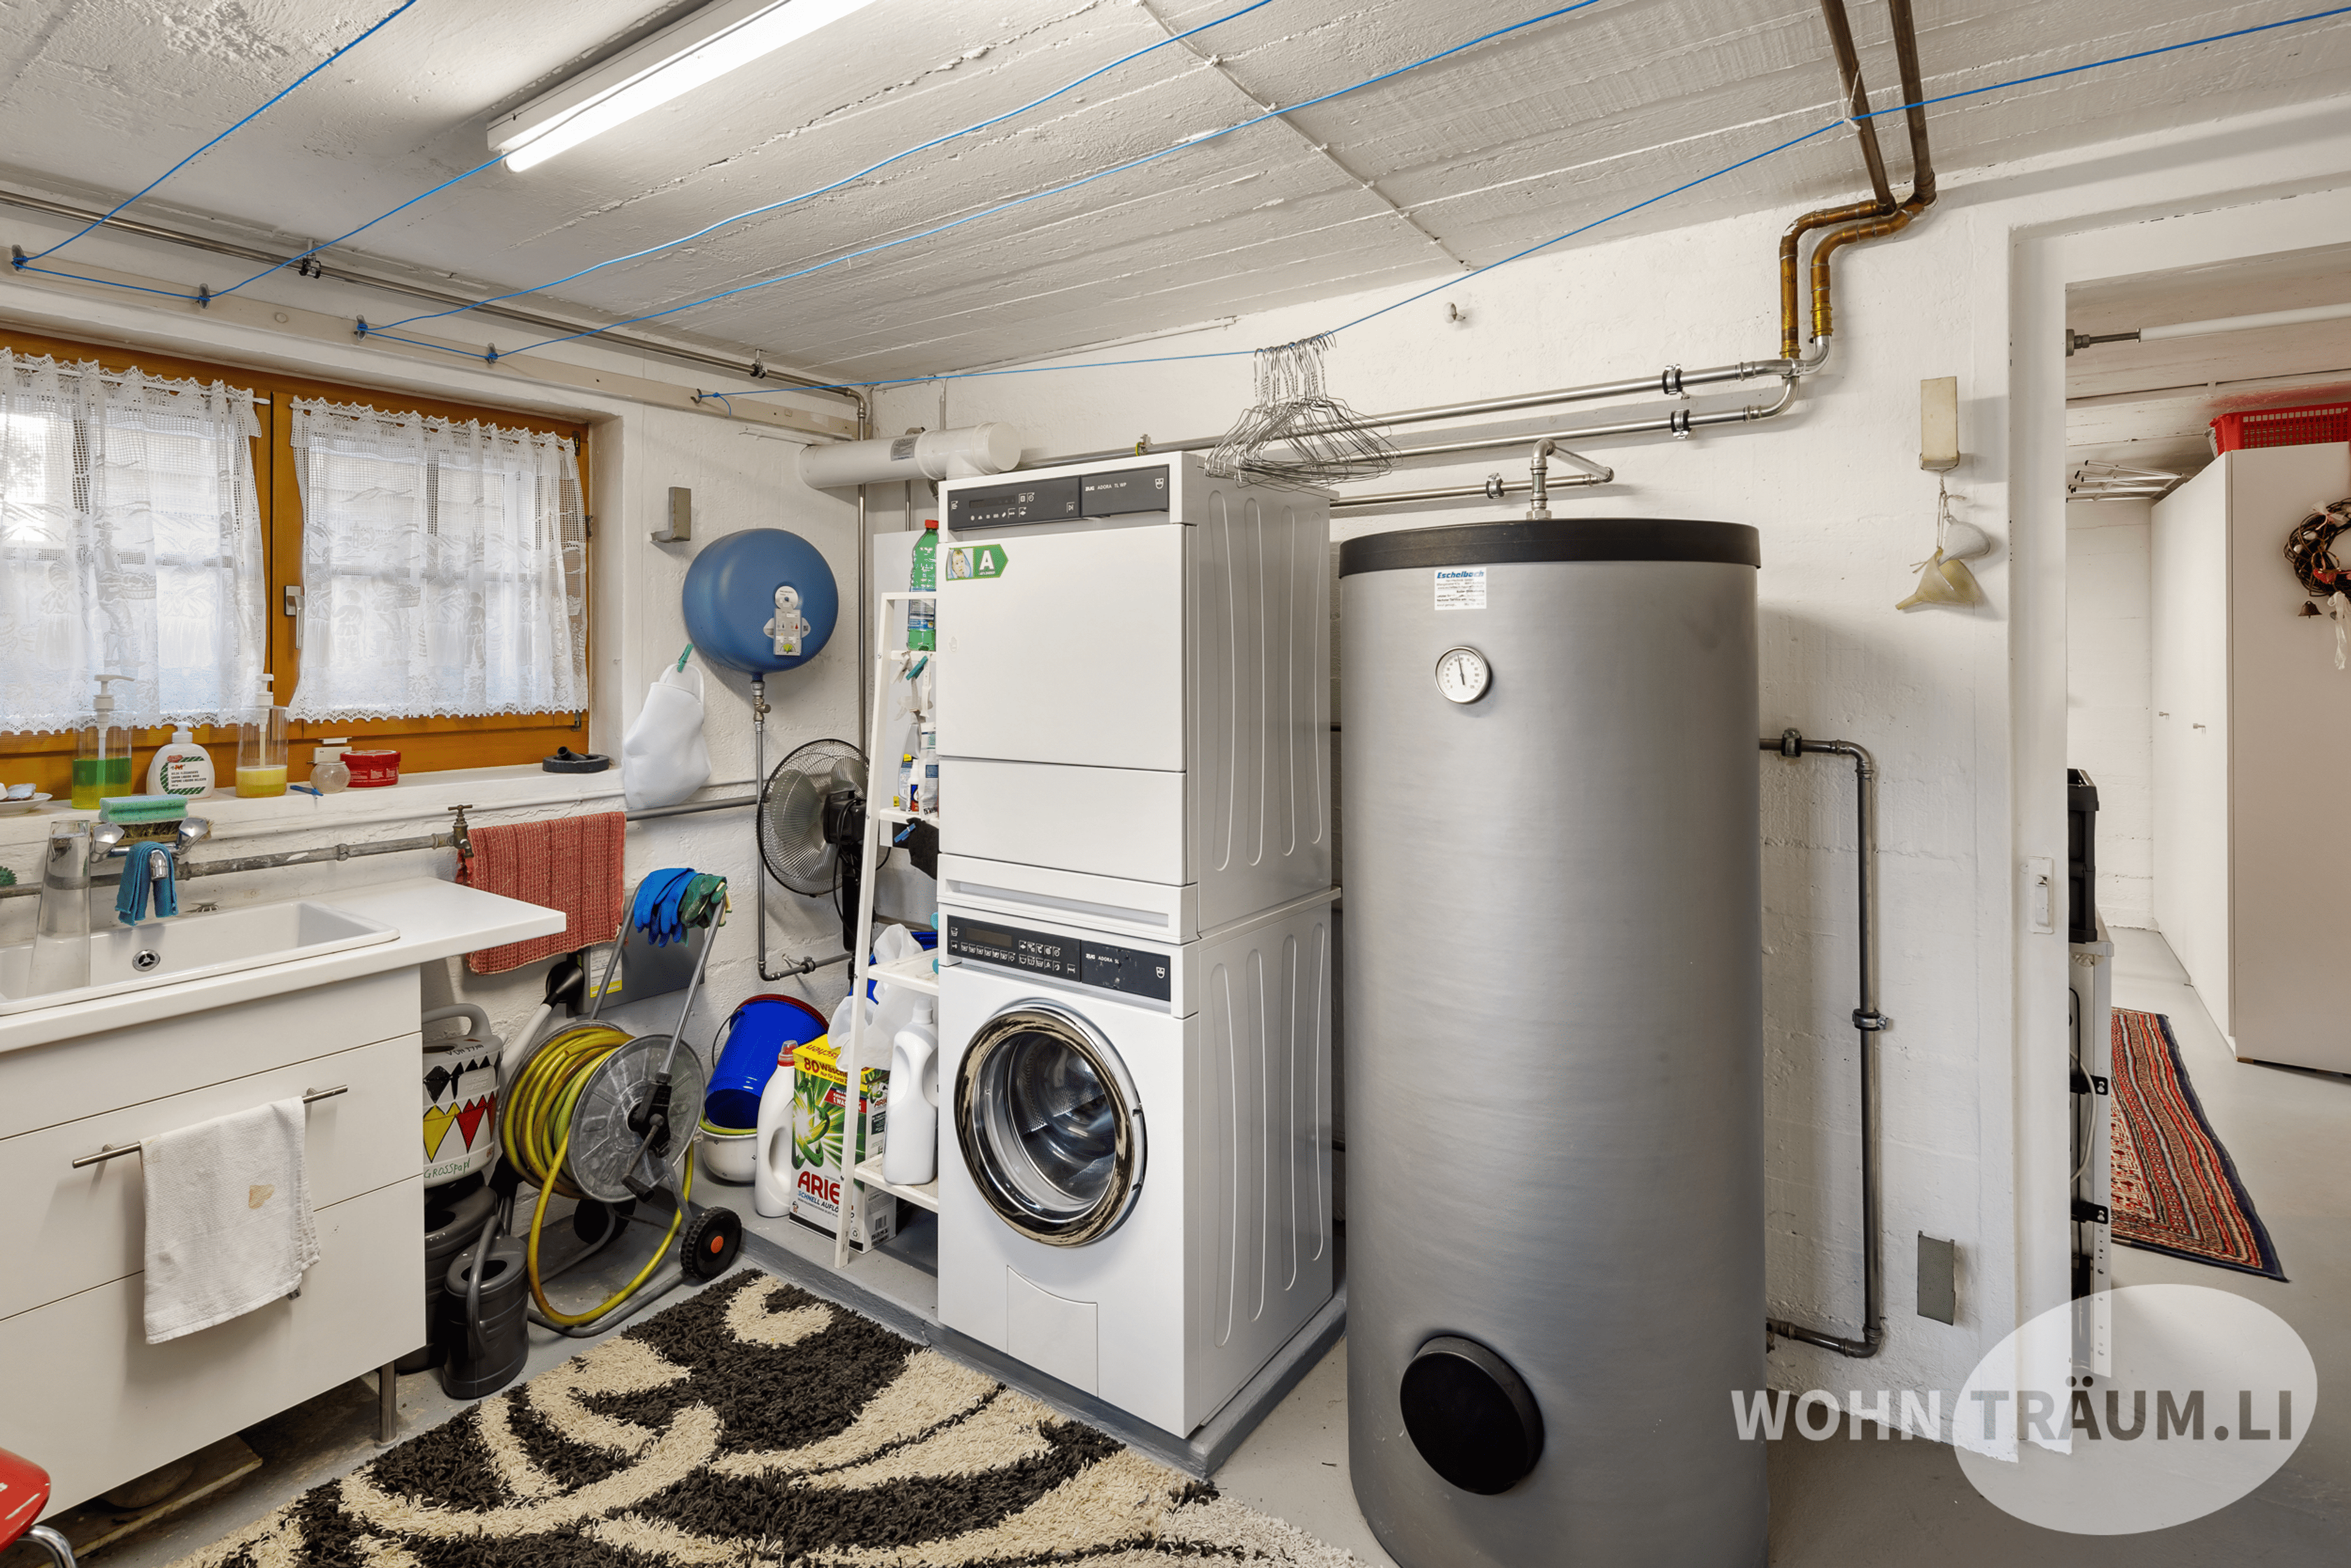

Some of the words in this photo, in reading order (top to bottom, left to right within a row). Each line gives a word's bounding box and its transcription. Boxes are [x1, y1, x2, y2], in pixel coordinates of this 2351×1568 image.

[980, 550, 994, 570] A
[804, 1057, 820, 1073] 80
[797, 1171, 840, 1206] ARIE
